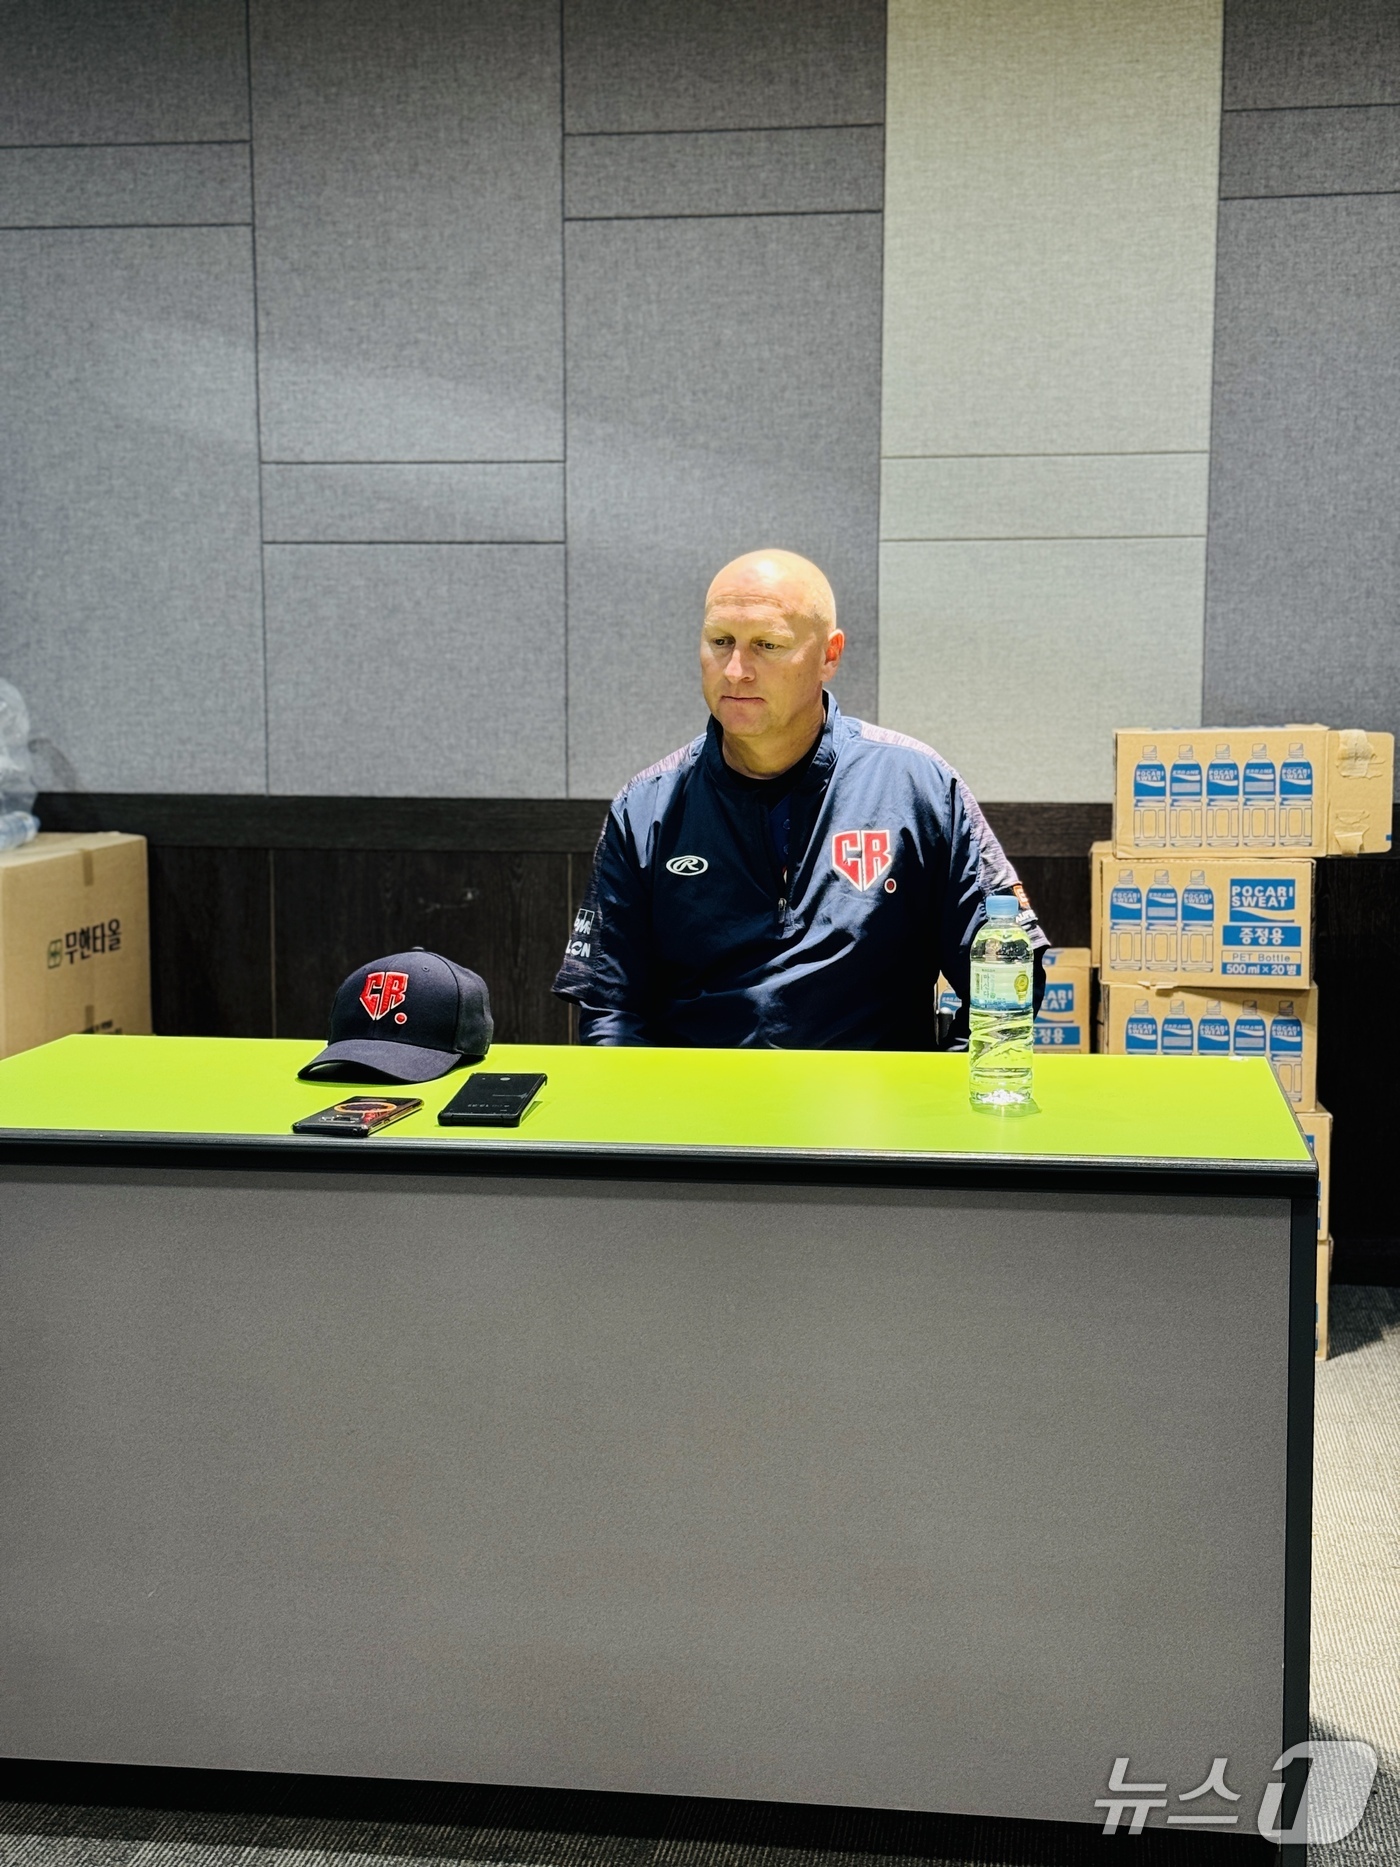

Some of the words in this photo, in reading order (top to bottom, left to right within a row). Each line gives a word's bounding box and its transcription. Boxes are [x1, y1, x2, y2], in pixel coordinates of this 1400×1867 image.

[1231, 886, 1294, 897] POCARI
[1231, 896, 1287, 907] SWEAT
[1239, 927, 1285, 945] 증정용
[1232, 953, 1253, 962] PET
[1258, 953, 1291, 962] Bottle
[1045, 989, 1073, 1000] ARI
[1041, 1000, 1067, 1010] EAT
